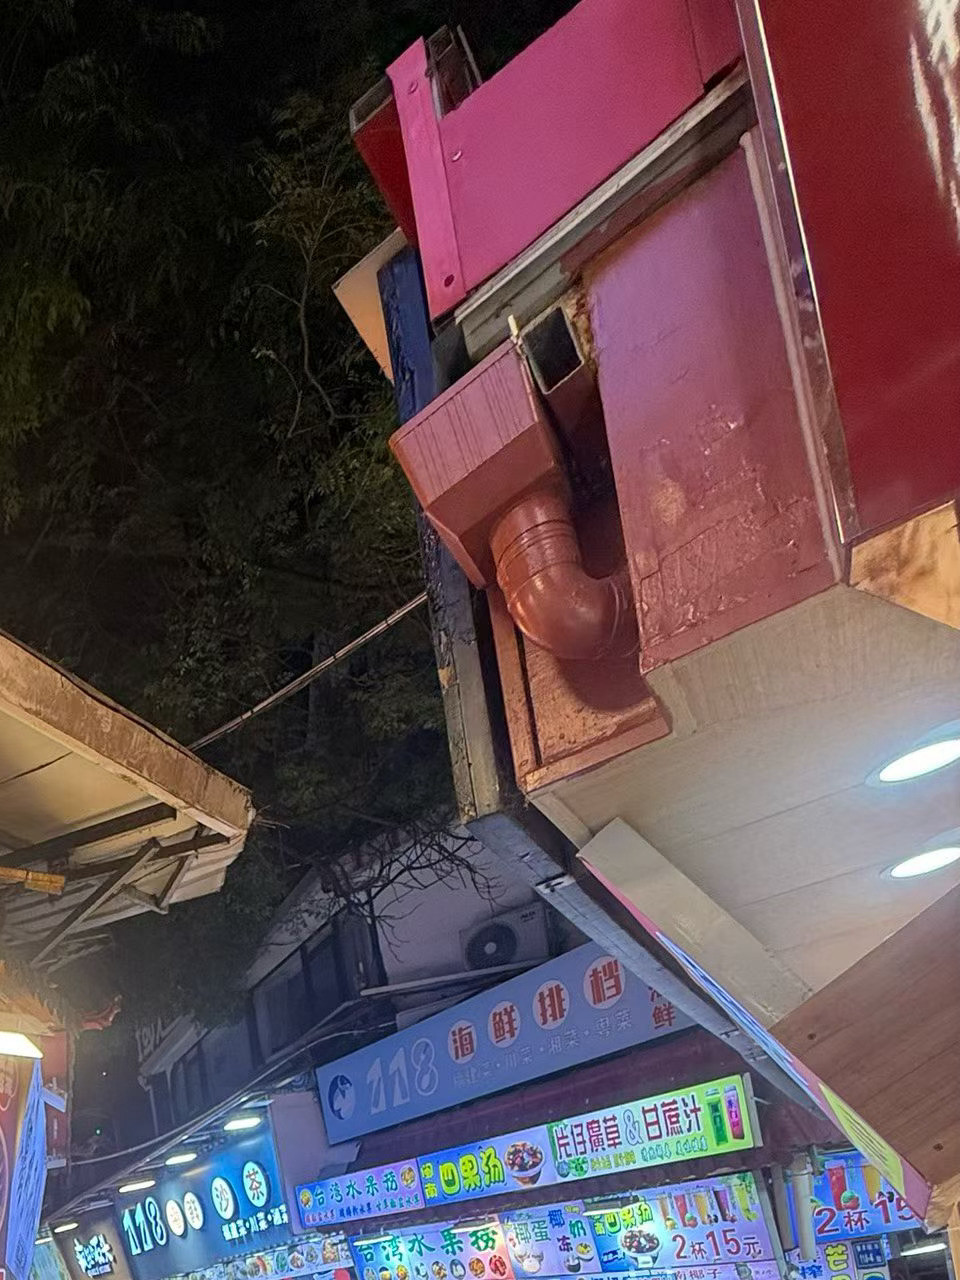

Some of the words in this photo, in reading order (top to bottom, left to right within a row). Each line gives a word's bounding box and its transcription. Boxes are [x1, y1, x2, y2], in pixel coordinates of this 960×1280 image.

[451, 959, 622, 1061] 海鲜排档
[123, 1197, 167, 1255] 118
[671, 1228, 762, 1260] 2杯15元
